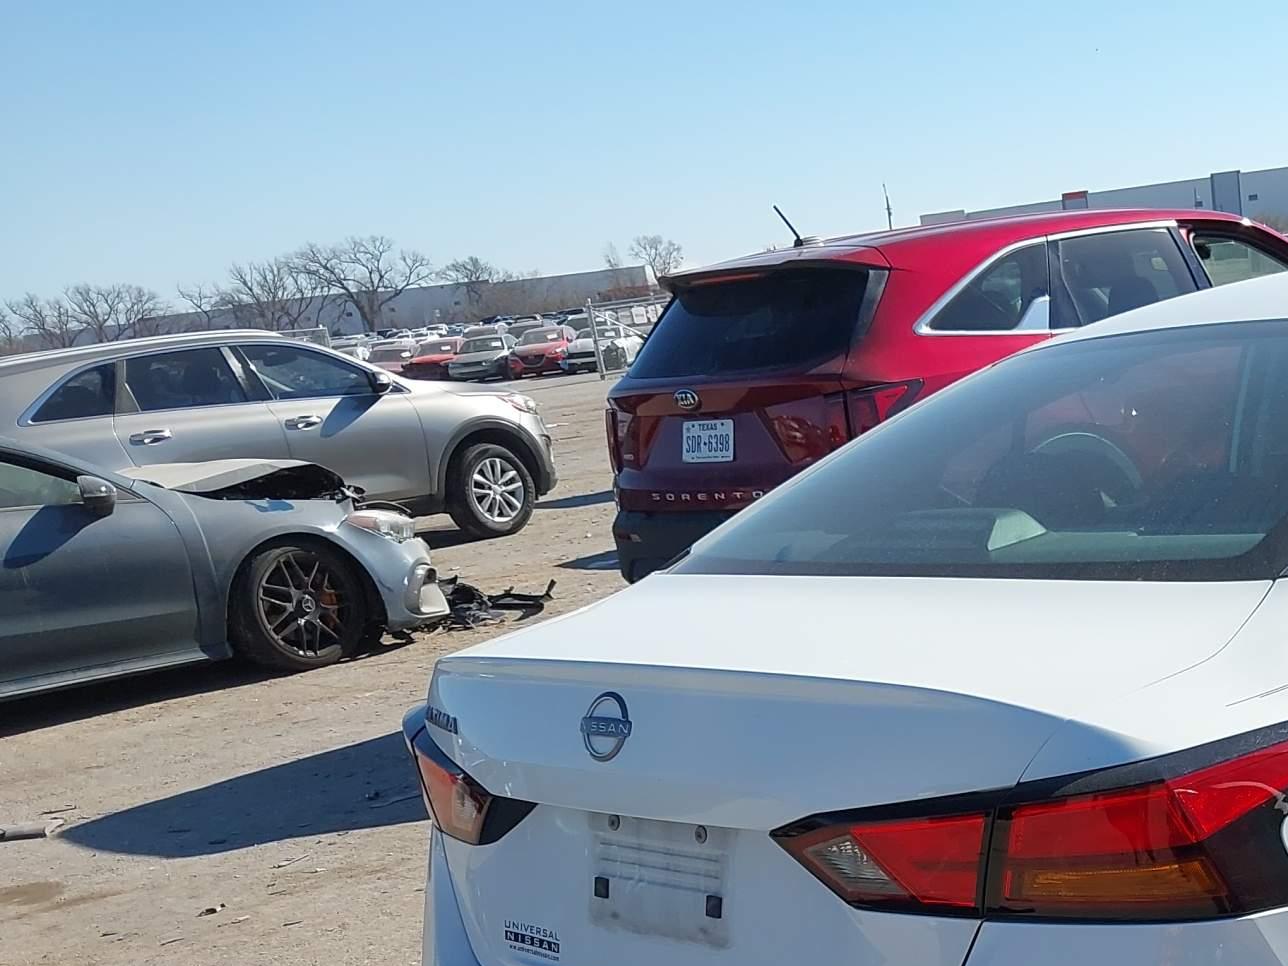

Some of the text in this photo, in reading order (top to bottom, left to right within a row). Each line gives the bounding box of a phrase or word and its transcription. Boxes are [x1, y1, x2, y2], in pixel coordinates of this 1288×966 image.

[698, 423, 718, 431] TEXAS
[651, 490, 764, 501] SORENTO
[582, 717, 631, 736] NSSAN
[504, 919, 561, 942] UNIVERSAL
[506, 931, 559, 953] NISSAN
